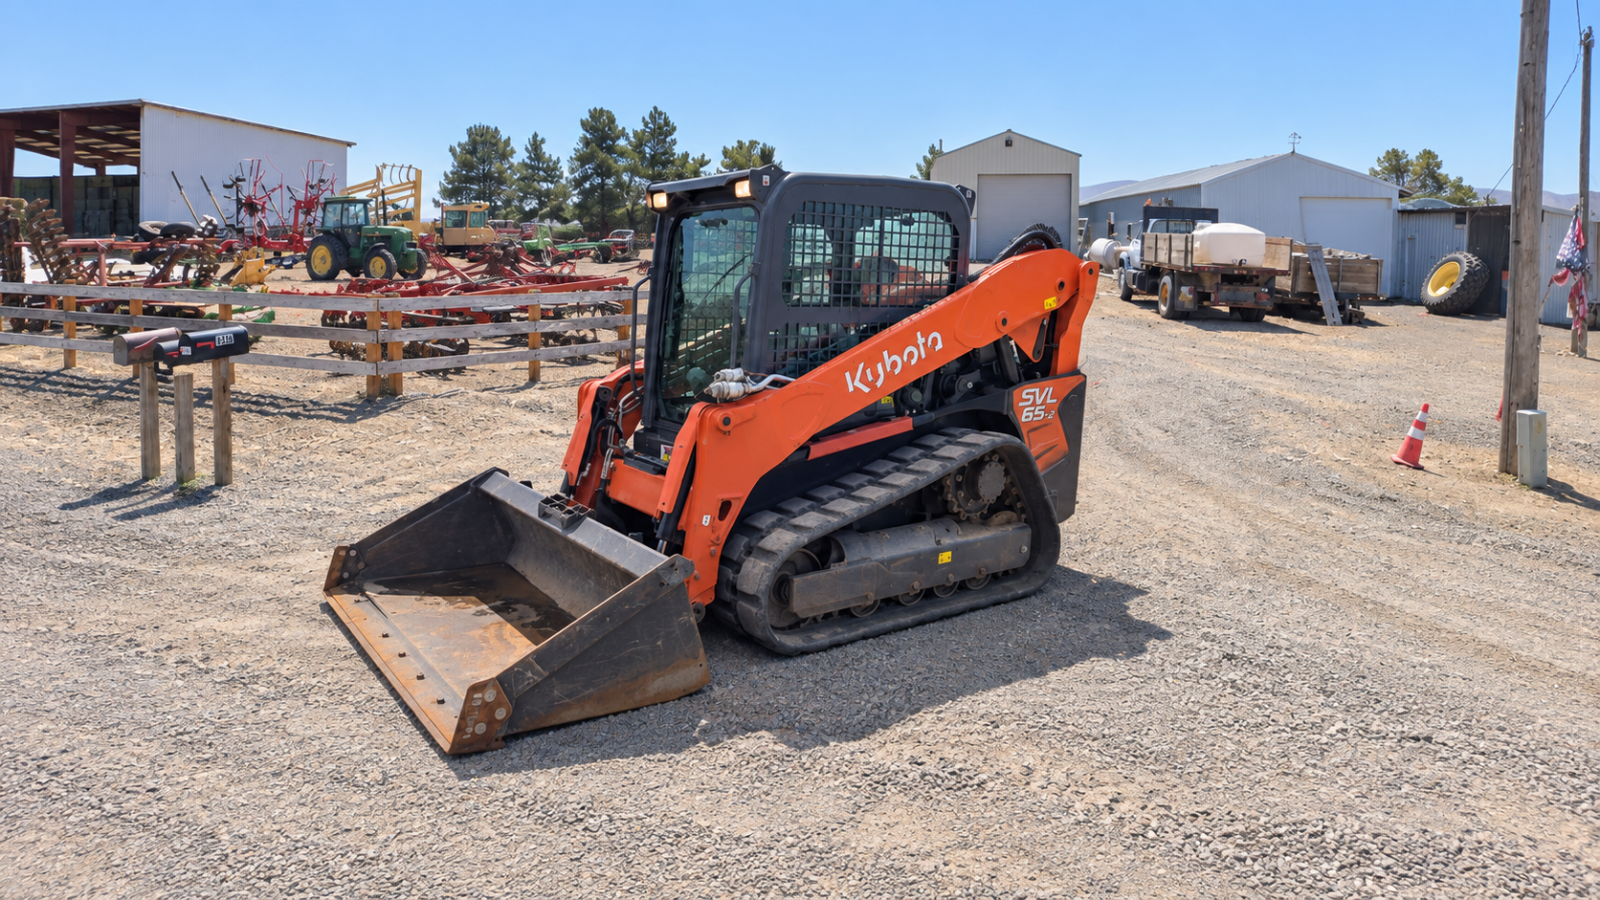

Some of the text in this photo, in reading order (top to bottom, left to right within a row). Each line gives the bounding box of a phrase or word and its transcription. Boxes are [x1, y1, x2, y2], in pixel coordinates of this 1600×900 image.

[844, 331, 943, 393] Kubota
[1018, 387, 1057, 407] SVL
[1021, 405, 1055, 422] 65-2
